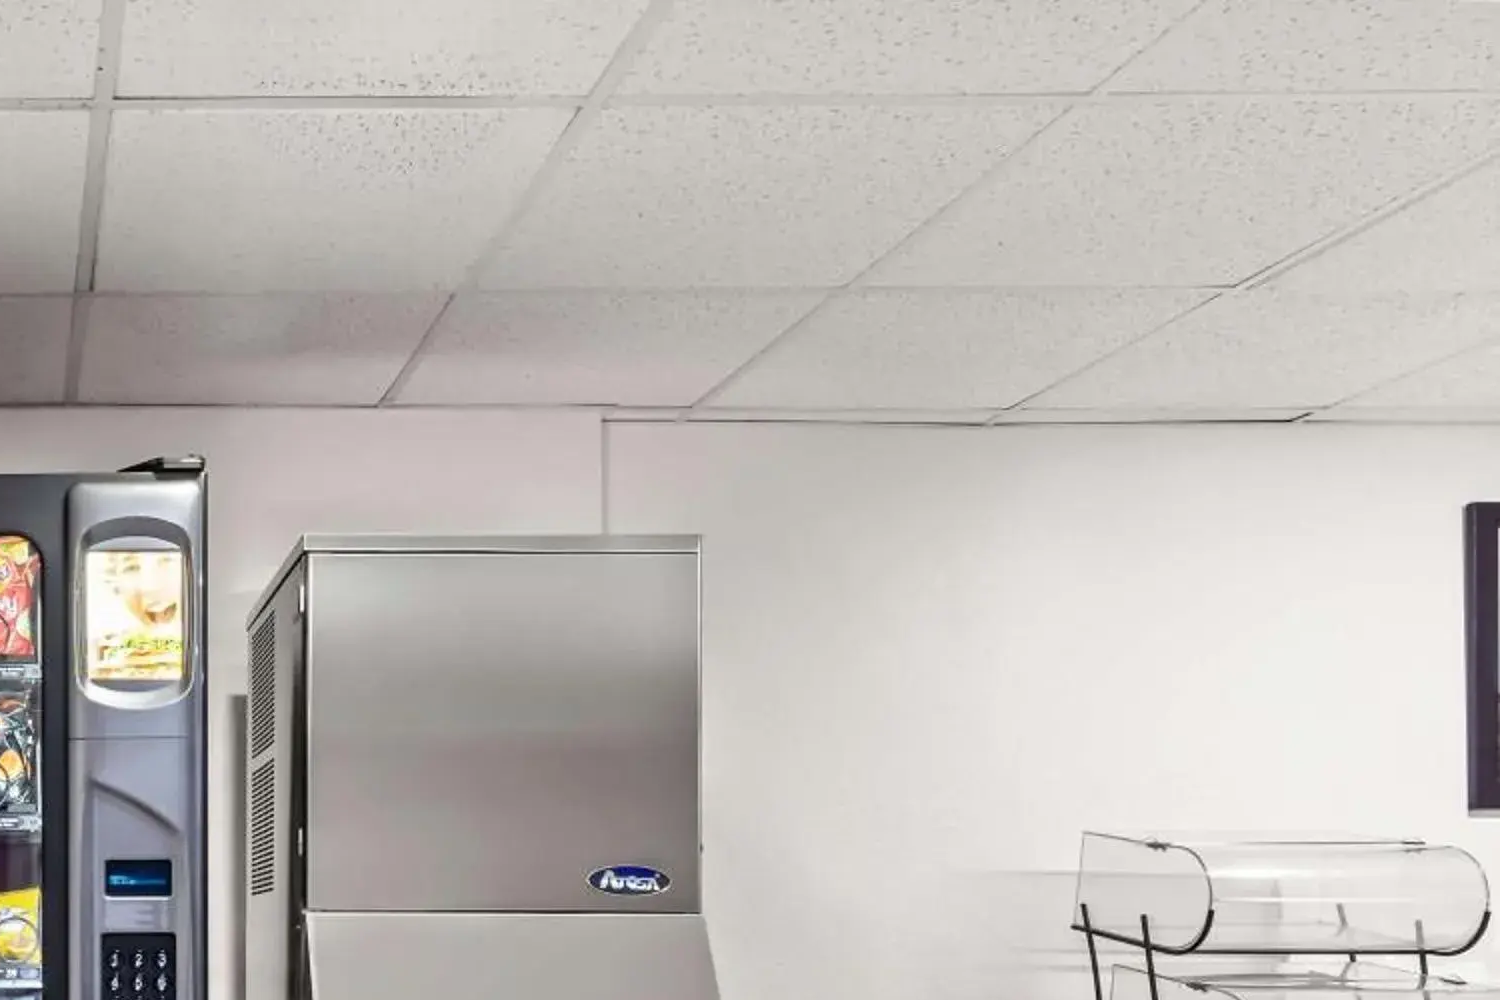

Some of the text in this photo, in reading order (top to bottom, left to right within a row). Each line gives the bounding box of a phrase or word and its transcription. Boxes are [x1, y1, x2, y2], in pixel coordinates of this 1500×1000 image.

[111, 953, 167, 968] 1 2 3
